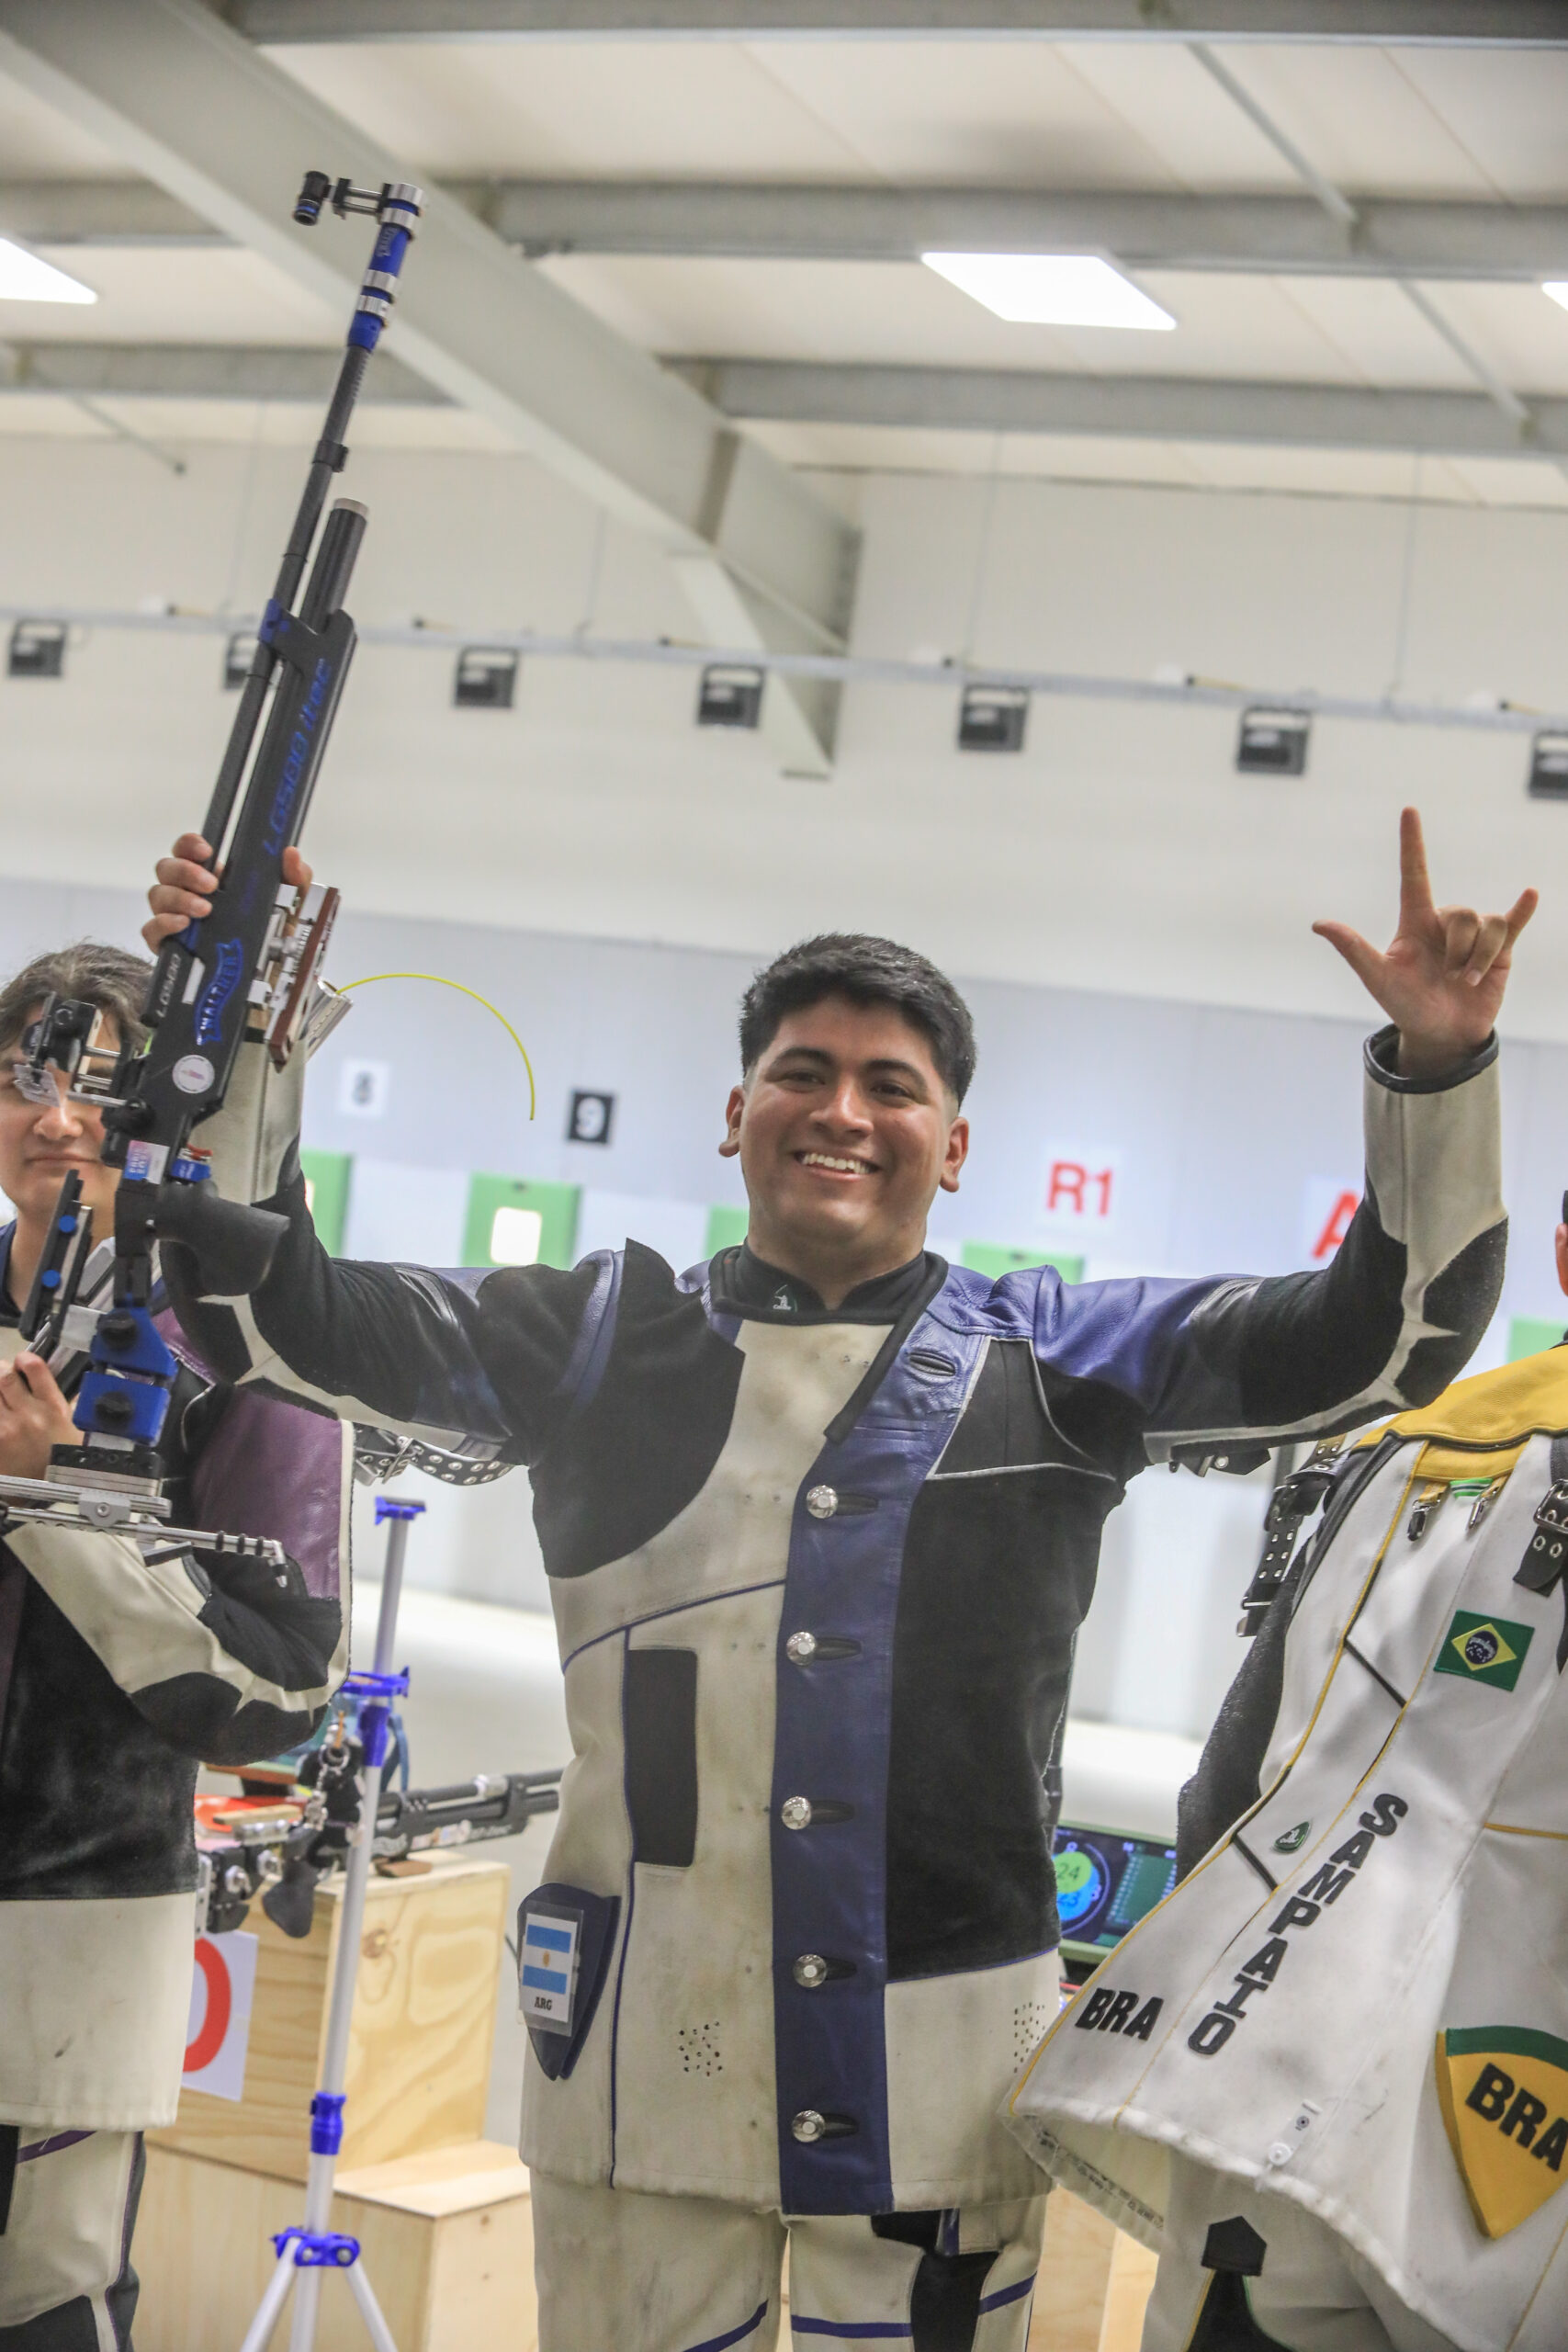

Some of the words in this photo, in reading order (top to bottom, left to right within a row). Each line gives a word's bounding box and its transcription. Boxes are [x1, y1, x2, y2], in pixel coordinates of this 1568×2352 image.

[199, 956, 237, 1031] WALTHER
[575, 1096, 607, 1141] 9
[1047, 1159, 1113, 1216] R1
[1187, 1792, 1409, 2056] SAMPAIO
[534, 1996, 553, 2011] ARG
[1074, 1987, 1165, 2041] BRA
[1464, 2062, 1568, 2173] BRA
